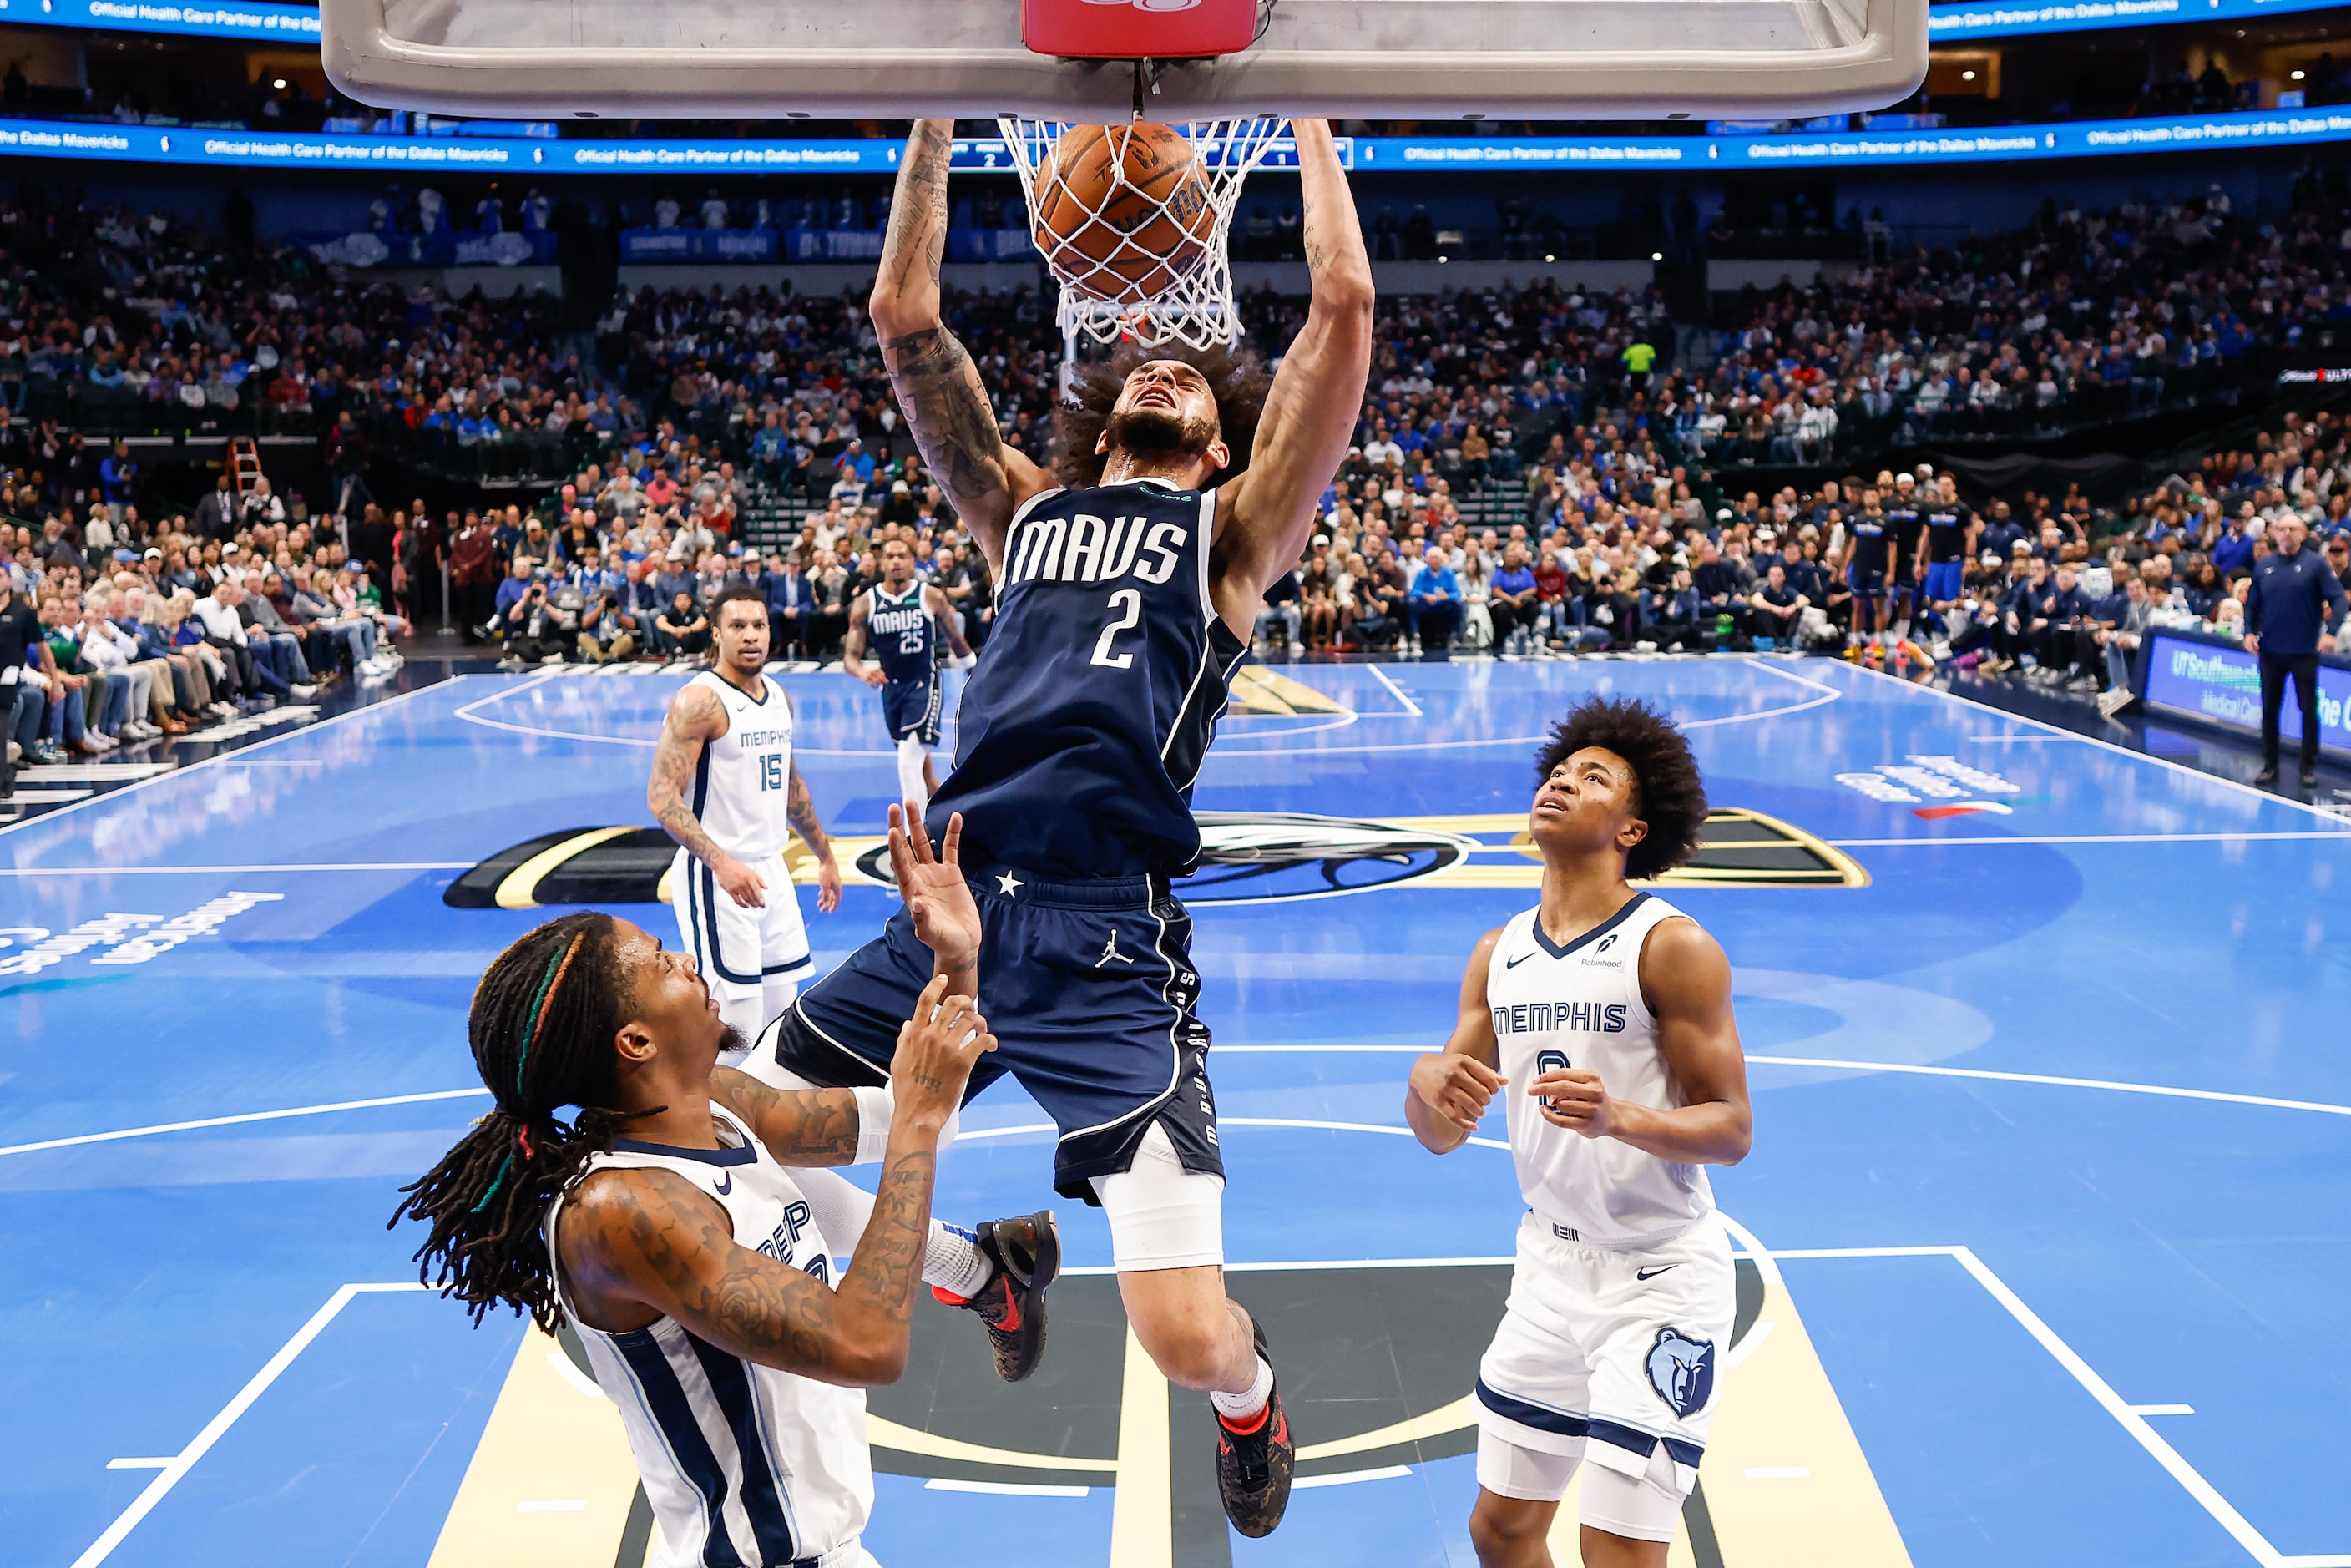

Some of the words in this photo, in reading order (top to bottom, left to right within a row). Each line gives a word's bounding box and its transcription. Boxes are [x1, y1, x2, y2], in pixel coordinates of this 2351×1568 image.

[205, 140, 249, 154] Official
[251, 143, 291, 155] Health
[293, 144, 323, 156] Care
[325, 144, 370, 158] Partner
[372, 146, 385, 159] of
[387, 147, 407, 159] the
[408, 147, 446, 159] Dallas
[447, 148, 508, 161] Mavericks
[575, 150, 616, 162] Official
[618, 150, 656, 162] Health
[657, 149, 685, 162] Care
[685, 150, 729, 162] Partner
[730, 150, 743, 161] of
[744, 151, 764, 161] the
[765, 149, 801, 162] Dallas
[801, 150, 859, 161] Mavericks
[1011, 514, 1188, 585] MAVS
[873, 608, 923, 635] MAVS
[1090, 589, 1142, 670] 2
[900, 630, 923, 655] 25
[741, 729, 791, 747] MEMPHIS
[759, 753, 782, 792] 15
[89, 890, 286, 965] American
[1580, 959, 1623, 969] Robinhood
[1494, 1002, 1627, 1034] MEMPHIS
